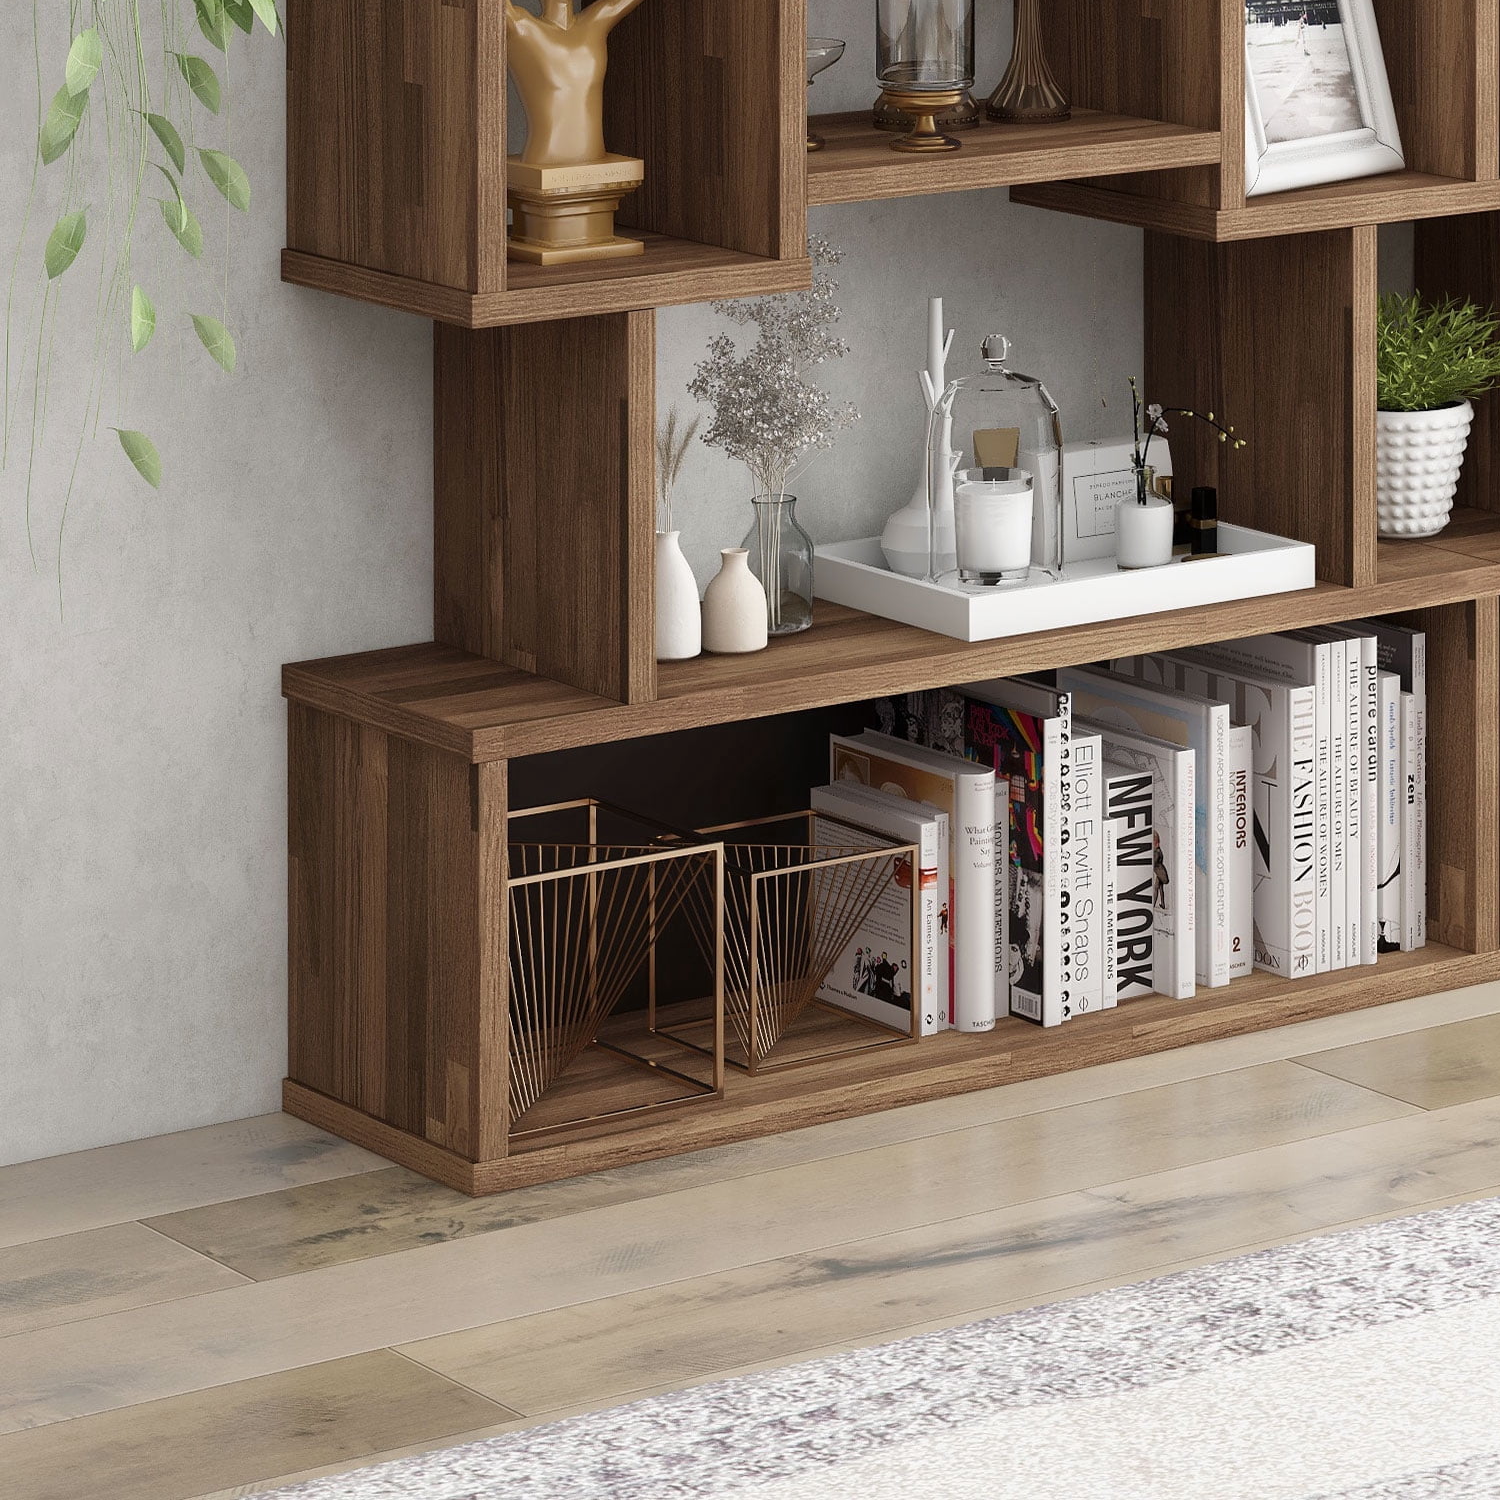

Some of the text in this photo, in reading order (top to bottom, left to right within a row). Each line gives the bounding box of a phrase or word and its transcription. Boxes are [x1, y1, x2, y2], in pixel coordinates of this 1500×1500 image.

[1093, 488, 1133, 501] BLANCHE
[1349, 658, 1358, 839] THE ALLURE OF BEAUTY
[1364, 665, 1377, 782] pierre cardin
[965, 826, 987, 836] What
[1071, 745, 1093, 982] Elliott Erwitt Snaps
[1236, 770, 1246, 849] INTERIORS
[1293, 691, 1314, 974] THE FASHION BOOK
[1318, 736, 1327, 898] THE ALLURE OF WOMEN
[1334, 734, 1342, 872] THE ALLURE OF MEN
[925, 898, 933, 977] An Eames Primer
[1105, 882, 1114, 980] THE AMERICANS
[1109, 775, 1153, 998] NEW YORK
